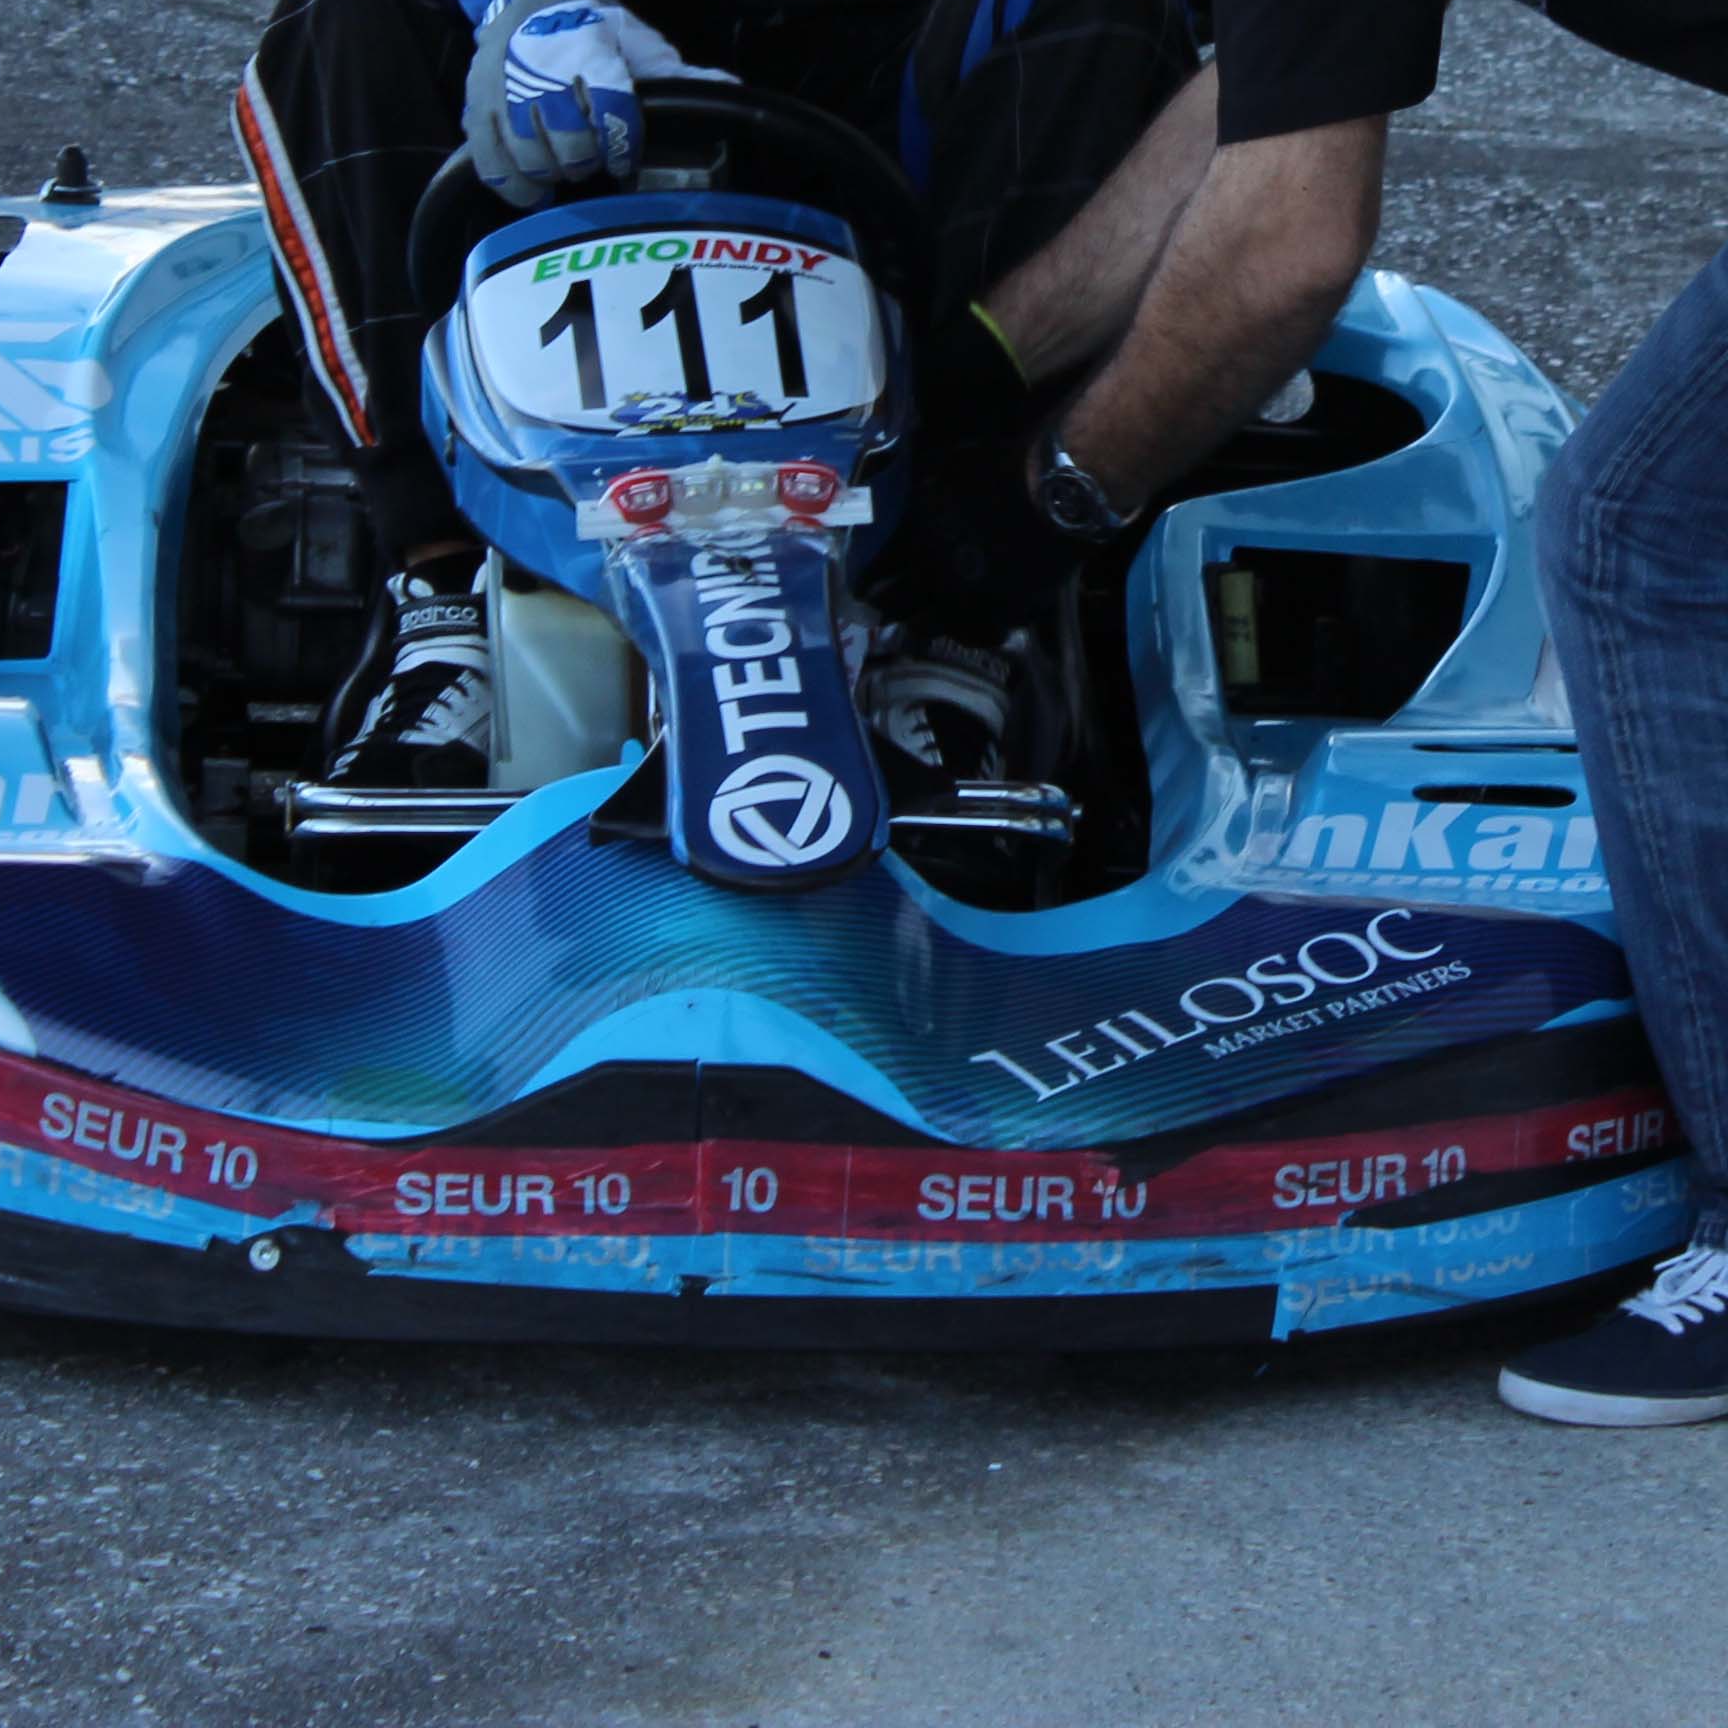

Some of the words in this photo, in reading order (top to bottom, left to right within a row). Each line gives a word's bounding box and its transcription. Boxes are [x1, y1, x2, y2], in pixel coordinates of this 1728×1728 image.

[531, 238, 830, 283] EUROINDY
[539, 267, 809, 410] 111
[399, 605, 478, 633] sparco
[969, 908, 1444, 1102] LEILOSOC
[1202, 1009, 1327, 1060] MARKET
[1327, 959, 1472, 1020] PARTNERS
[38, 1091, 187, 1174] SEUR
[203, 1138, 259, 1191] 10
[393, 1171, 556, 1217] SEUR
[572, 1173, 632, 1217] 10
[721, 1166, 779, 1214] 10
[916, 1173, 1075, 1222] SEUR
[1272, 1152, 1408, 1209] SEUR
[1421, 1144, 1468, 1189] 10
